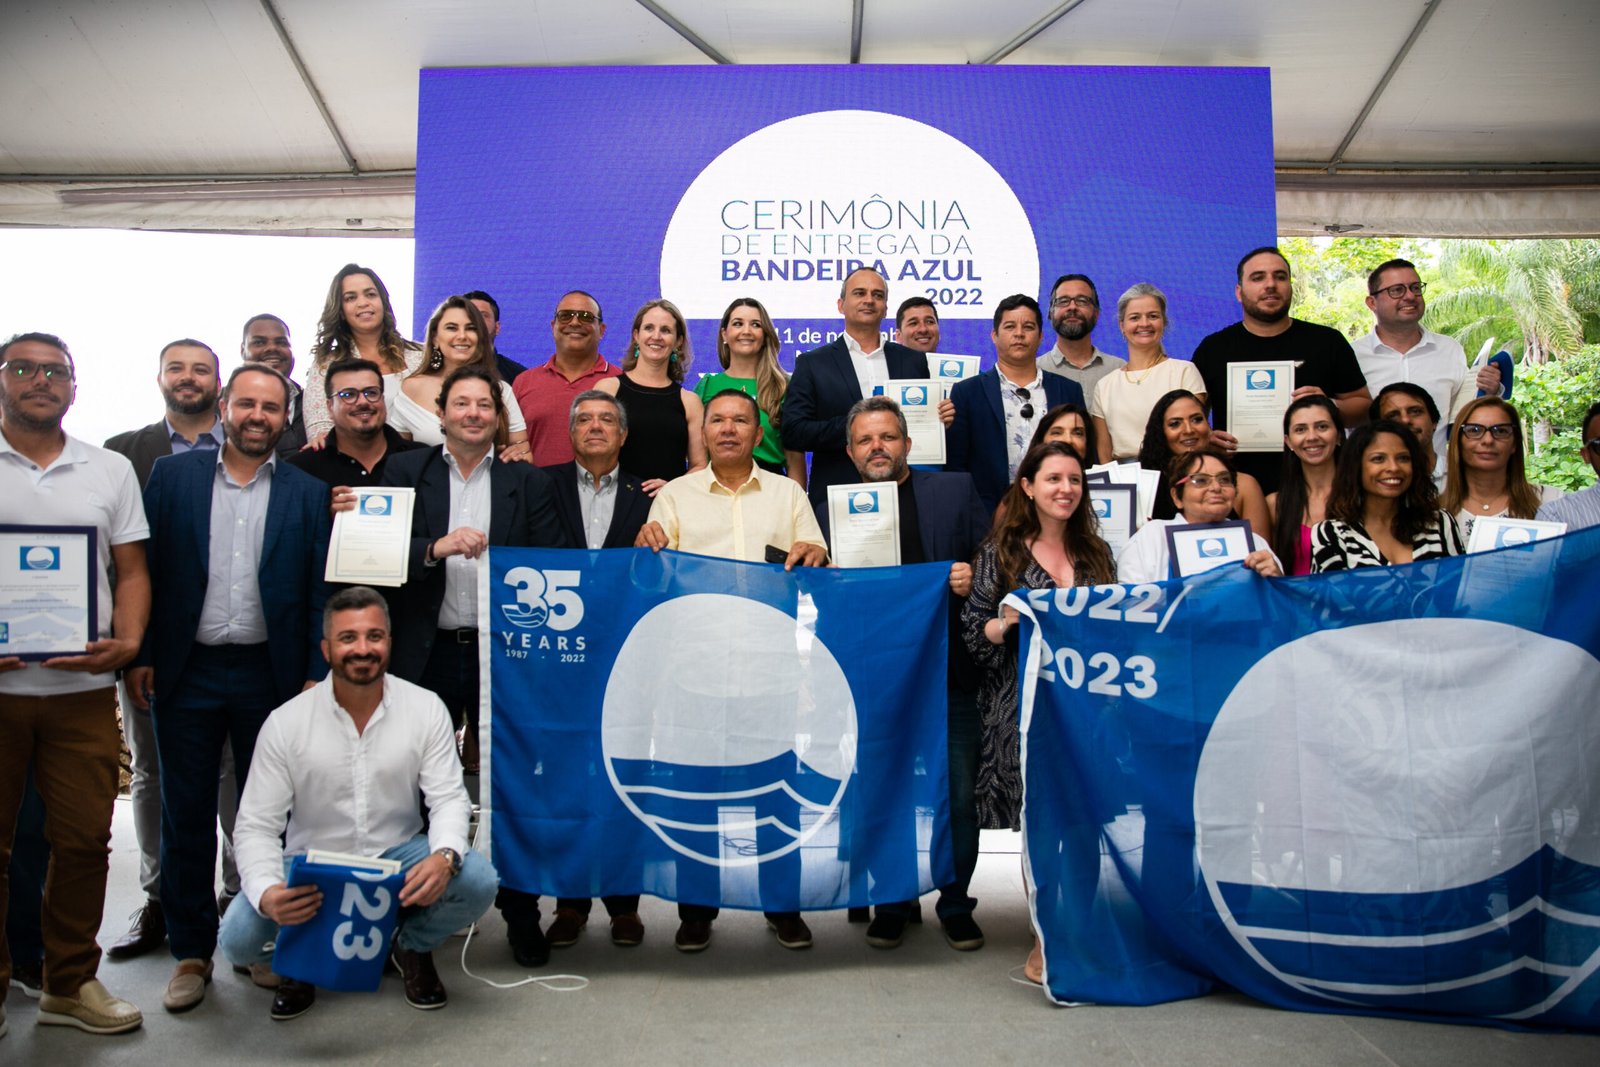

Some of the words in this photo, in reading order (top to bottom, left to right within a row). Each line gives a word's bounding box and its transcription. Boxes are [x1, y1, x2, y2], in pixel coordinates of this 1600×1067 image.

[721, 193, 970, 230] CERIMÔNIA
[721, 234, 761, 255] DE
[773, 234, 920, 255] ENTREGA
[931, 234, 973, 255] DA
[897, 259, 982, 281] AZUL
[925, 288, 983, 305] 2022
[798, 327, 822, 344] de
[501, 566, 584, 632] 35
[502, 631, 586, 651] YEARS
[505, 648, 528, 659] 1987
[560, 653, 585, 663] 2022
[332, 870, 392, 961] 23
